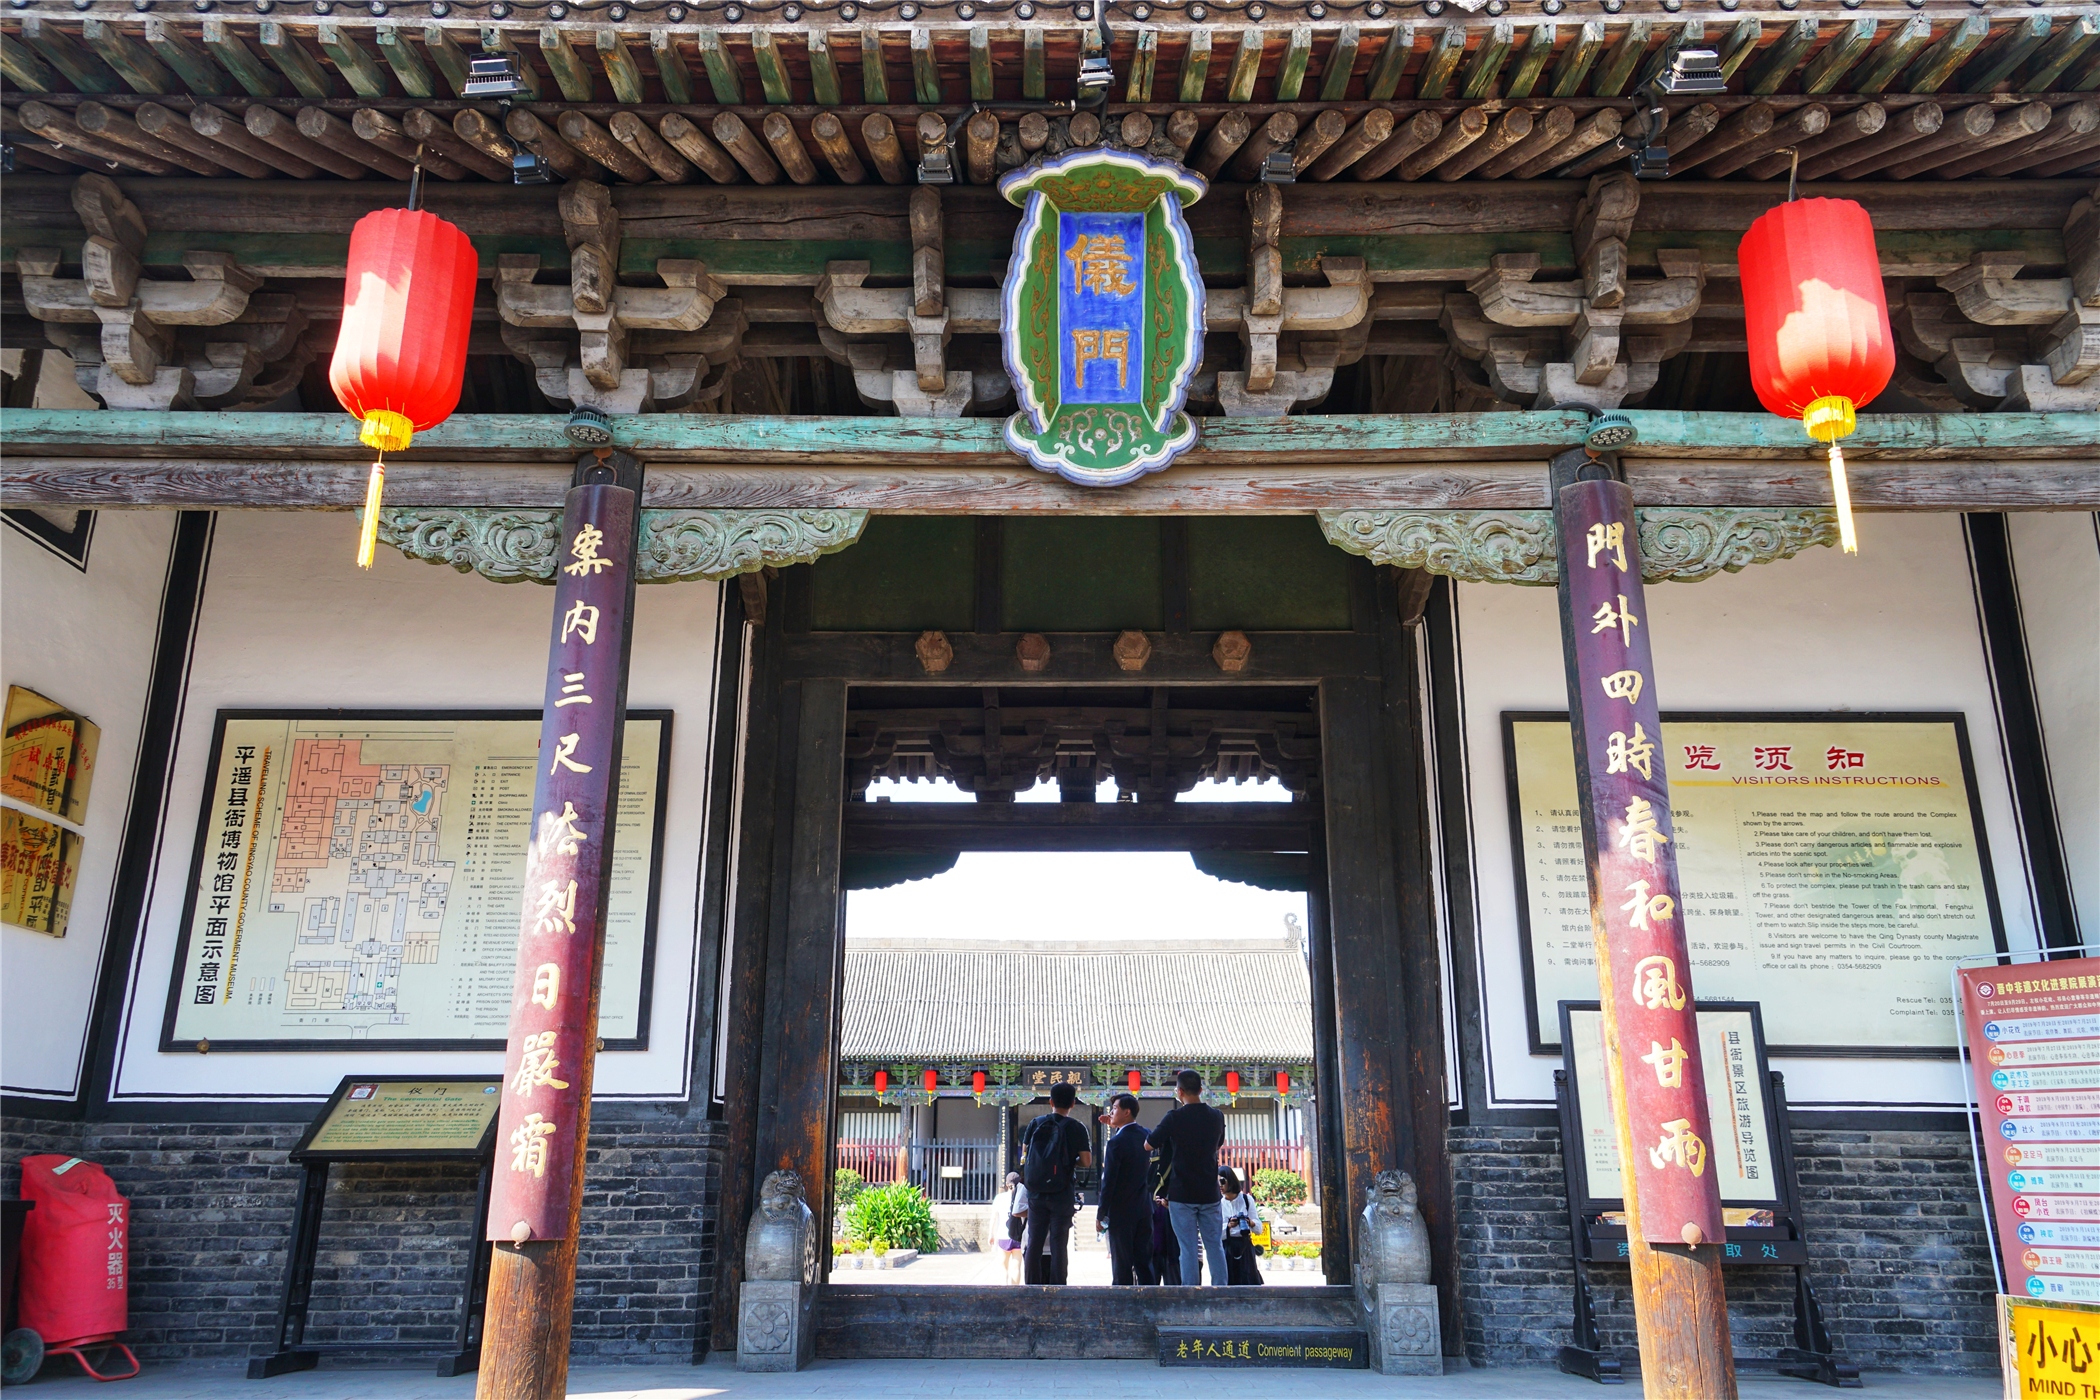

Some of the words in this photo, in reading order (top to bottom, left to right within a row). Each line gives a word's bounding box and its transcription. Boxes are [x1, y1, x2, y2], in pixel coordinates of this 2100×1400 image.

[1065, 233, 1137, 389] 儀門
[258, 750, 272, 794] TRAVELLING
[1684, 745, 1864, 770] 览须知
[1732, 776, 1810, 784] VISITORS
[1814, 777, 1941, 785] INSTRUCTIONS
[254, 796, 266, 828] SCHEME
[252, 830, 259, 841] OF
[246, 842, 257, 878] PINGYAO
[240, 878, 251, 911] COUNTY
[231, 912, 246, 963] GOVERMENT
[225, 963, 238, 999] MUSEUM
[1728, 1031, 1759, 1179] 县衙景区旅游导览图
[107, 1203, 124, 1276] 灭火器
[1176, 1339, 1252, 1359] 老年人通道
[1257, 1343, 1301, 1358] Convenient
[1305, 1347, 1353, 1361] passageway
[2027, 1320, 2100, 1373] 小心
[2029, 1377, 2076, 1396] MIND
